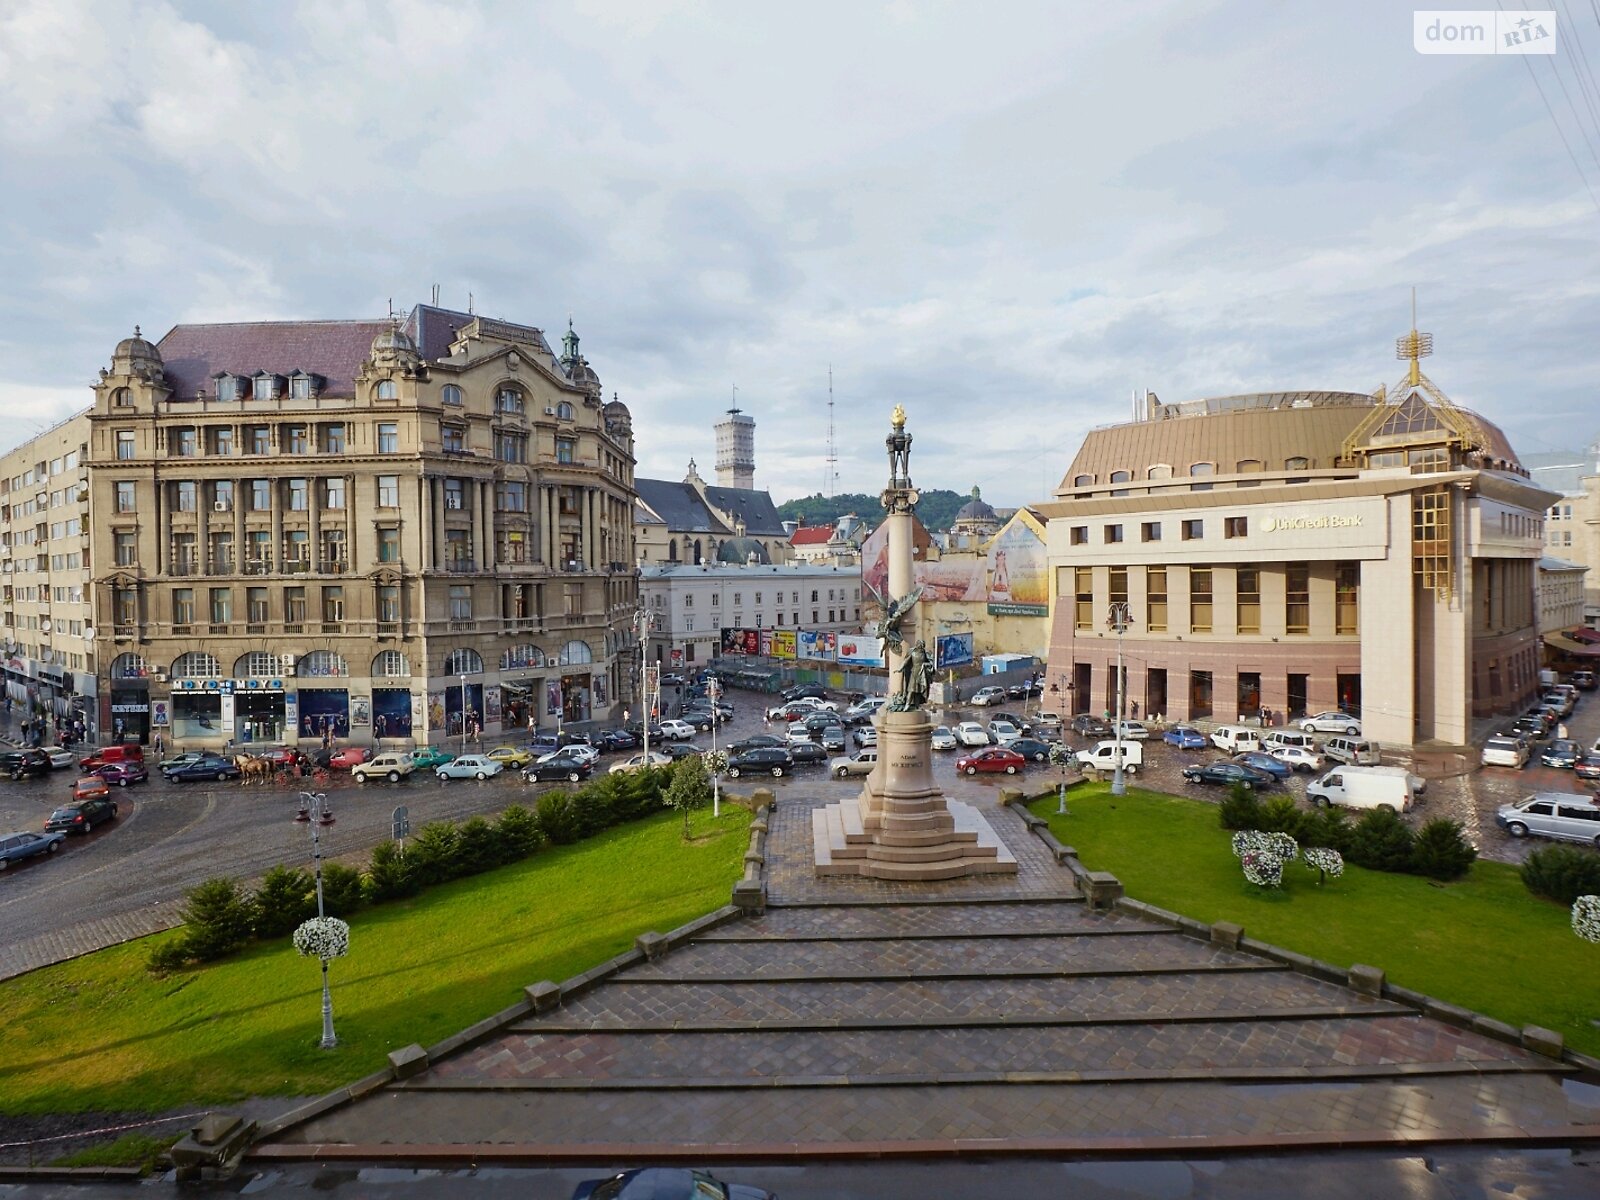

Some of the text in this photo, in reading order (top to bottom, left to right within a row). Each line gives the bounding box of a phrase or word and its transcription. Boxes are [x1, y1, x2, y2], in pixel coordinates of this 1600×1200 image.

[1277, 515, 1363, 530] UniCredit Bank
[173, 680, 217, 689] MOYO
[236, 679, 281, 689] MOYO
